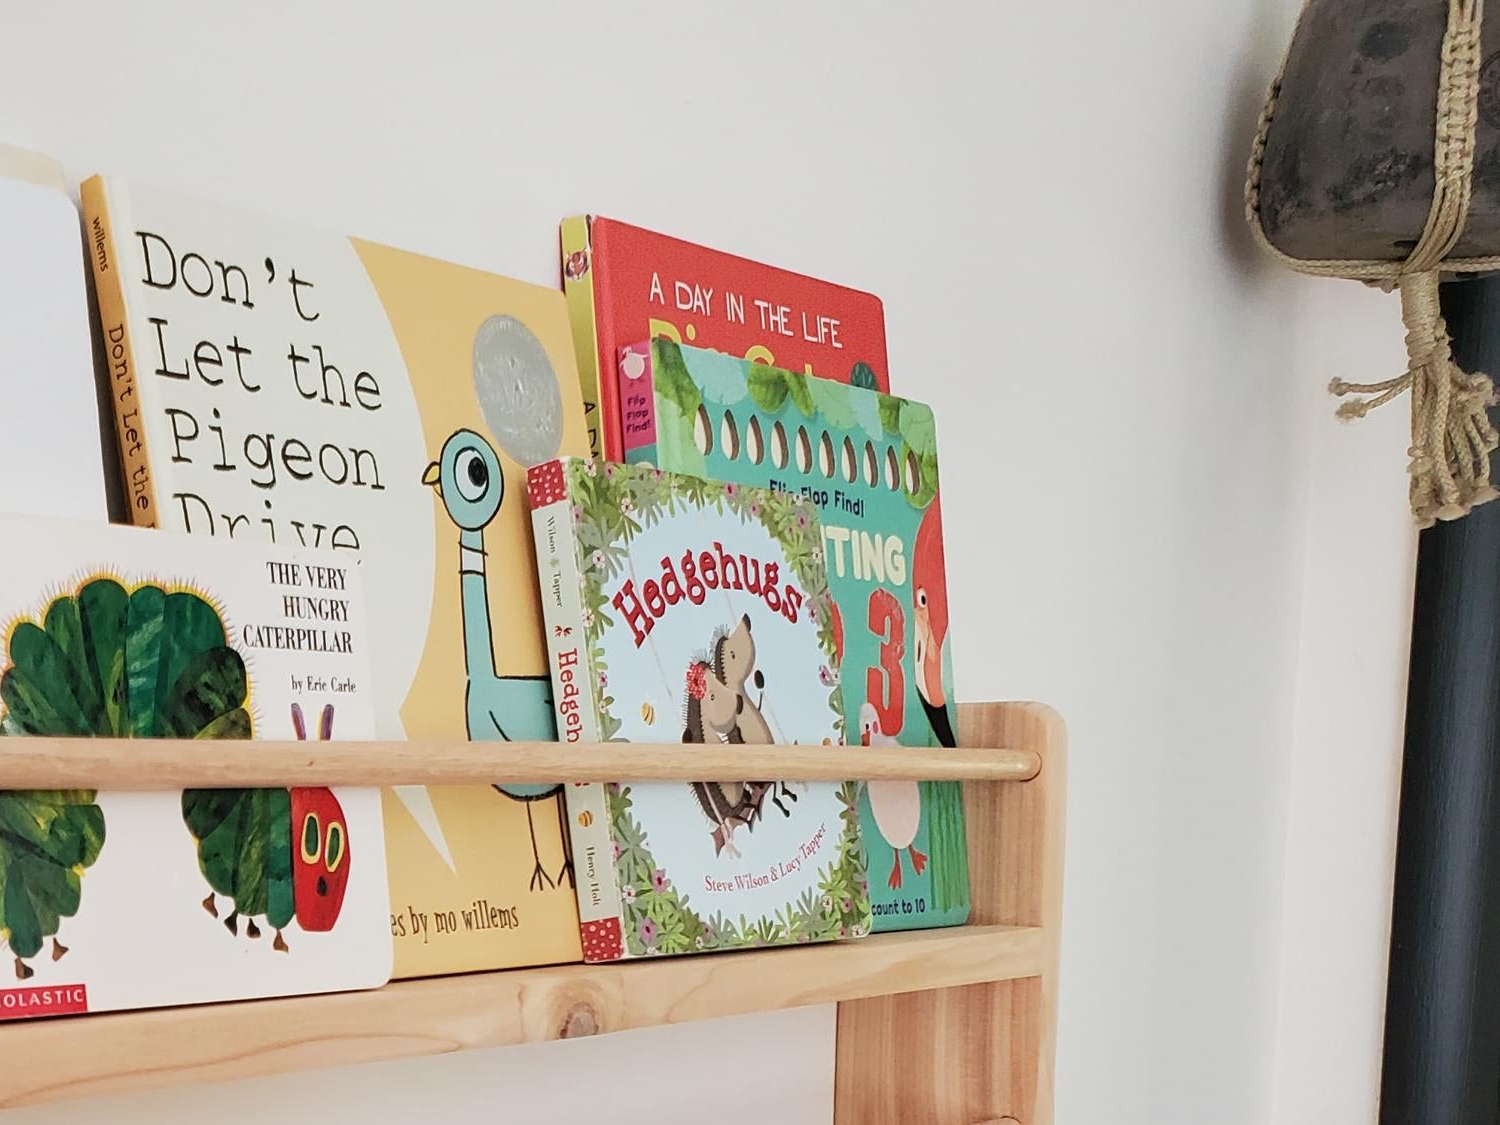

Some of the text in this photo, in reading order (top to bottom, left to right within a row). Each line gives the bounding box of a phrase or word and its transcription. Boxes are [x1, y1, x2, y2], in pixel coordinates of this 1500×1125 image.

[92, 216, 108, 272] willems
[135, 231, 320, 322] Don't
[650, 272, 665, 305] A
[674, 280, 714, 317] DAY
[725, 291, 745, 325] IN
[754, 300, 794, 337] THE
[802, 311, 843, 349] LIFE
[148, 317, 383, 411] Let the
[109, 323, 148, 511] Don't Let the
[583, 401, 596, 415] A
[627, 394, 646, 407] Flip
[164, 408, 386, 490] Pigeon
[835, 490, 865, 518] Find!
[266, 561, 348, 591] THE VERY
[547, 515, 563, 608] Wilson Tapper
[820, 524, 907, 587] TING
[283, 594, 350, 622] HUNGRY
[611, 541, 803, 650] Hedgehugs
[243, 624, 353, 654] CATERPILLAR
[291, 674, 357, 695] by Eric Carle
[558, 647, 582, 743] Hedgeh
[586, 846, 601, 906] Henry Holt
[704, 822, 827, 892] Steve Wilson & Lucy Tapper
[407, 905, 428, 944] by
[434, 910, 458, 935] mo
[461, 899, 520, 932] willems
[871, 902, 900, 917] count
[902, 899, 913, 914] to
